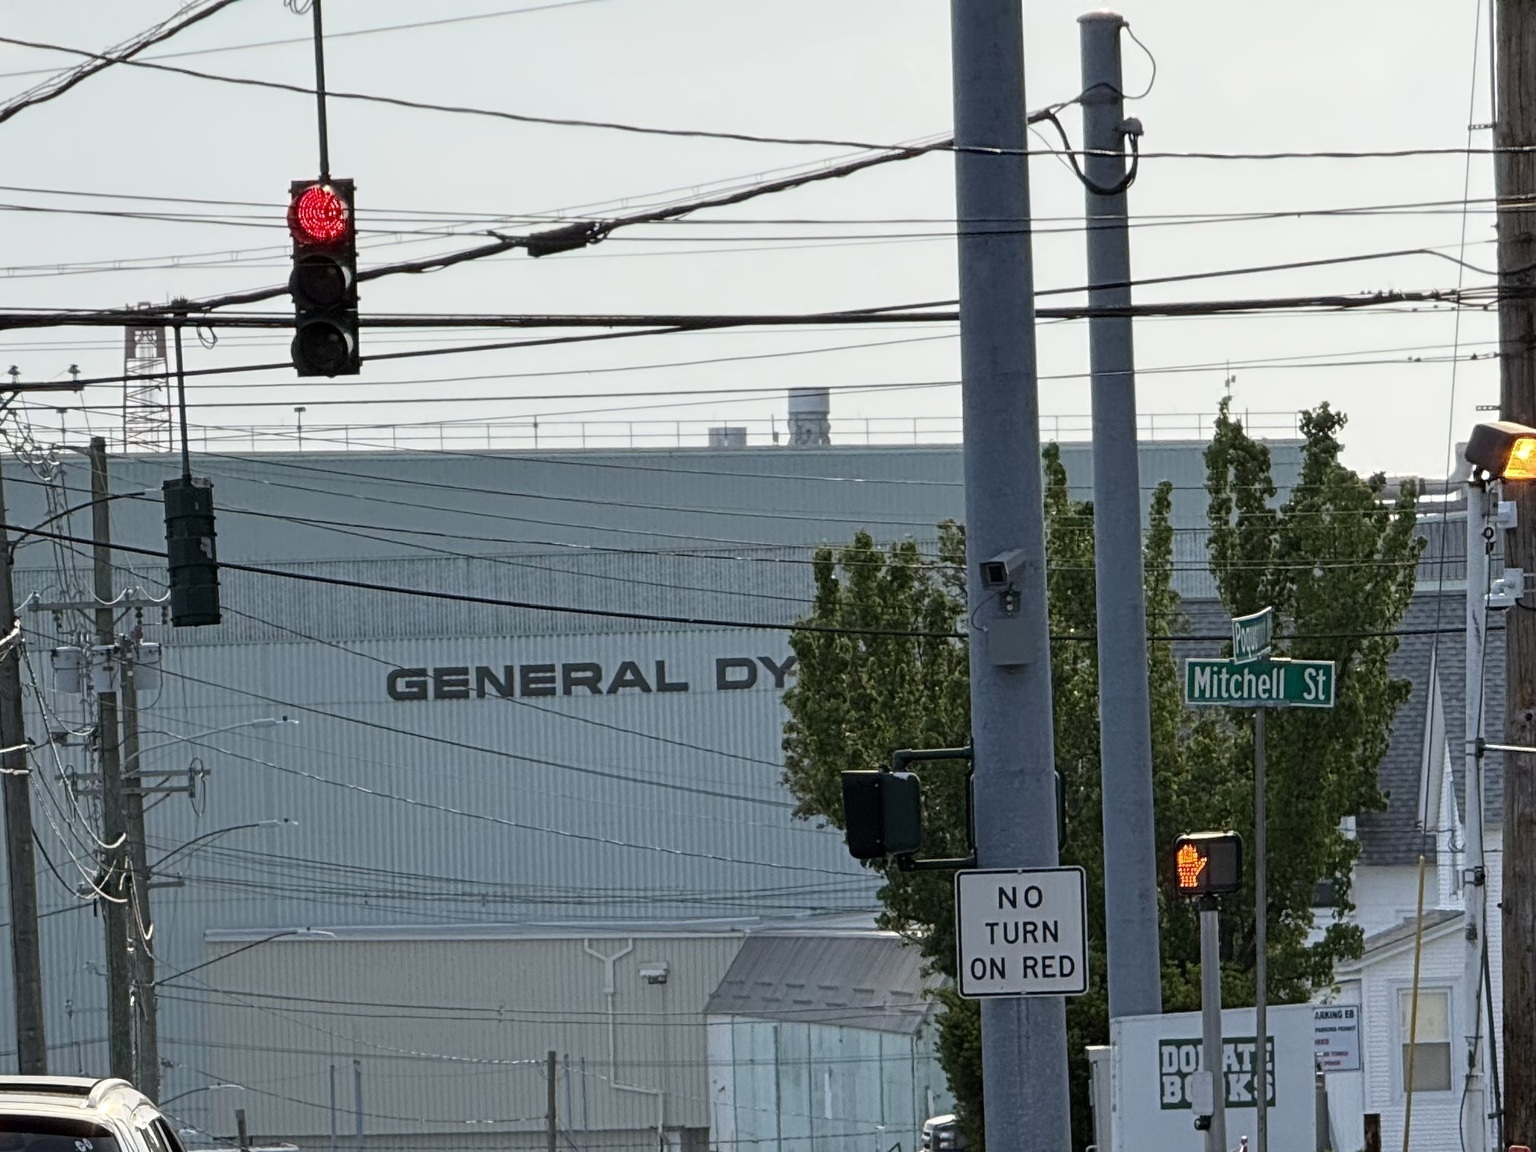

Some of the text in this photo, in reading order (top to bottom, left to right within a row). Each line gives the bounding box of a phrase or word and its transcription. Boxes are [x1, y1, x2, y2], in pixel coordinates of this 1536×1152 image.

[386, 659, 690, 701] GENERAL
[1194, 666, 1326, 701] Mitchell St
[998, 885, 1043, 909] NO
[985, 920, 1059, 945] TURN
[970, 955, 1075, 980] ON RED
[1162, 1072, 1273, 1104] BKS
